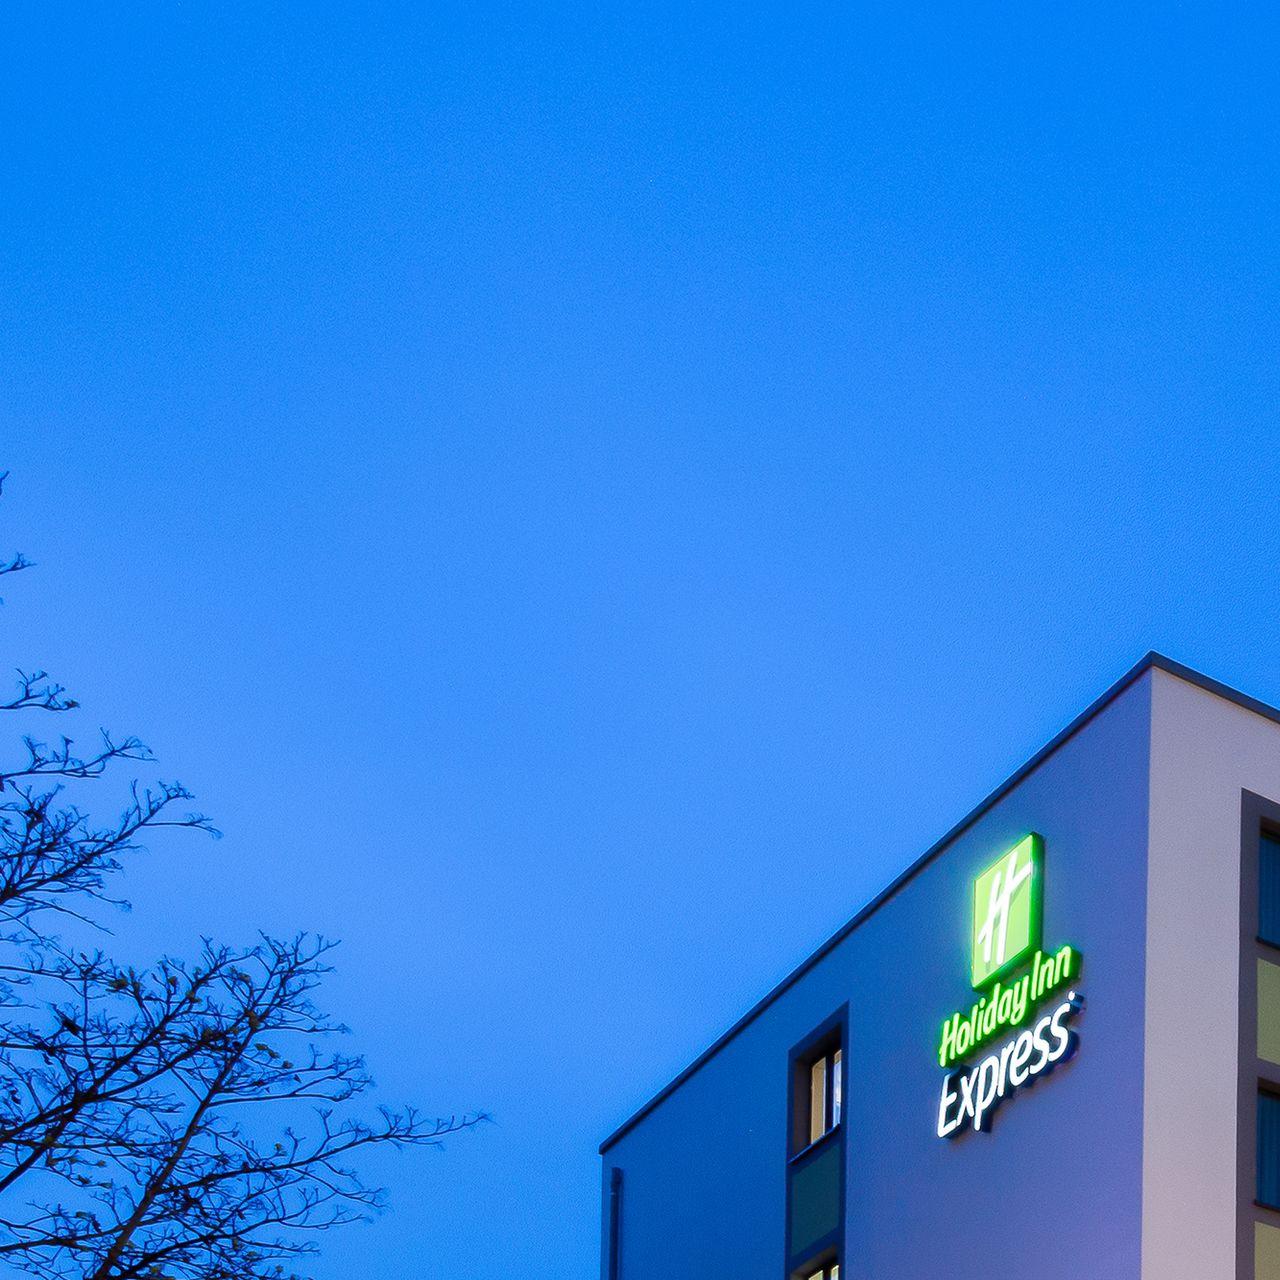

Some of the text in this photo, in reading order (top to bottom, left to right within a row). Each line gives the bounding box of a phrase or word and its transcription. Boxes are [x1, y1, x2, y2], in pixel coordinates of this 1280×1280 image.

[936, 1001, 1073, 1139] Express
[939, 945, 1072, 1068] Holiday Inn
